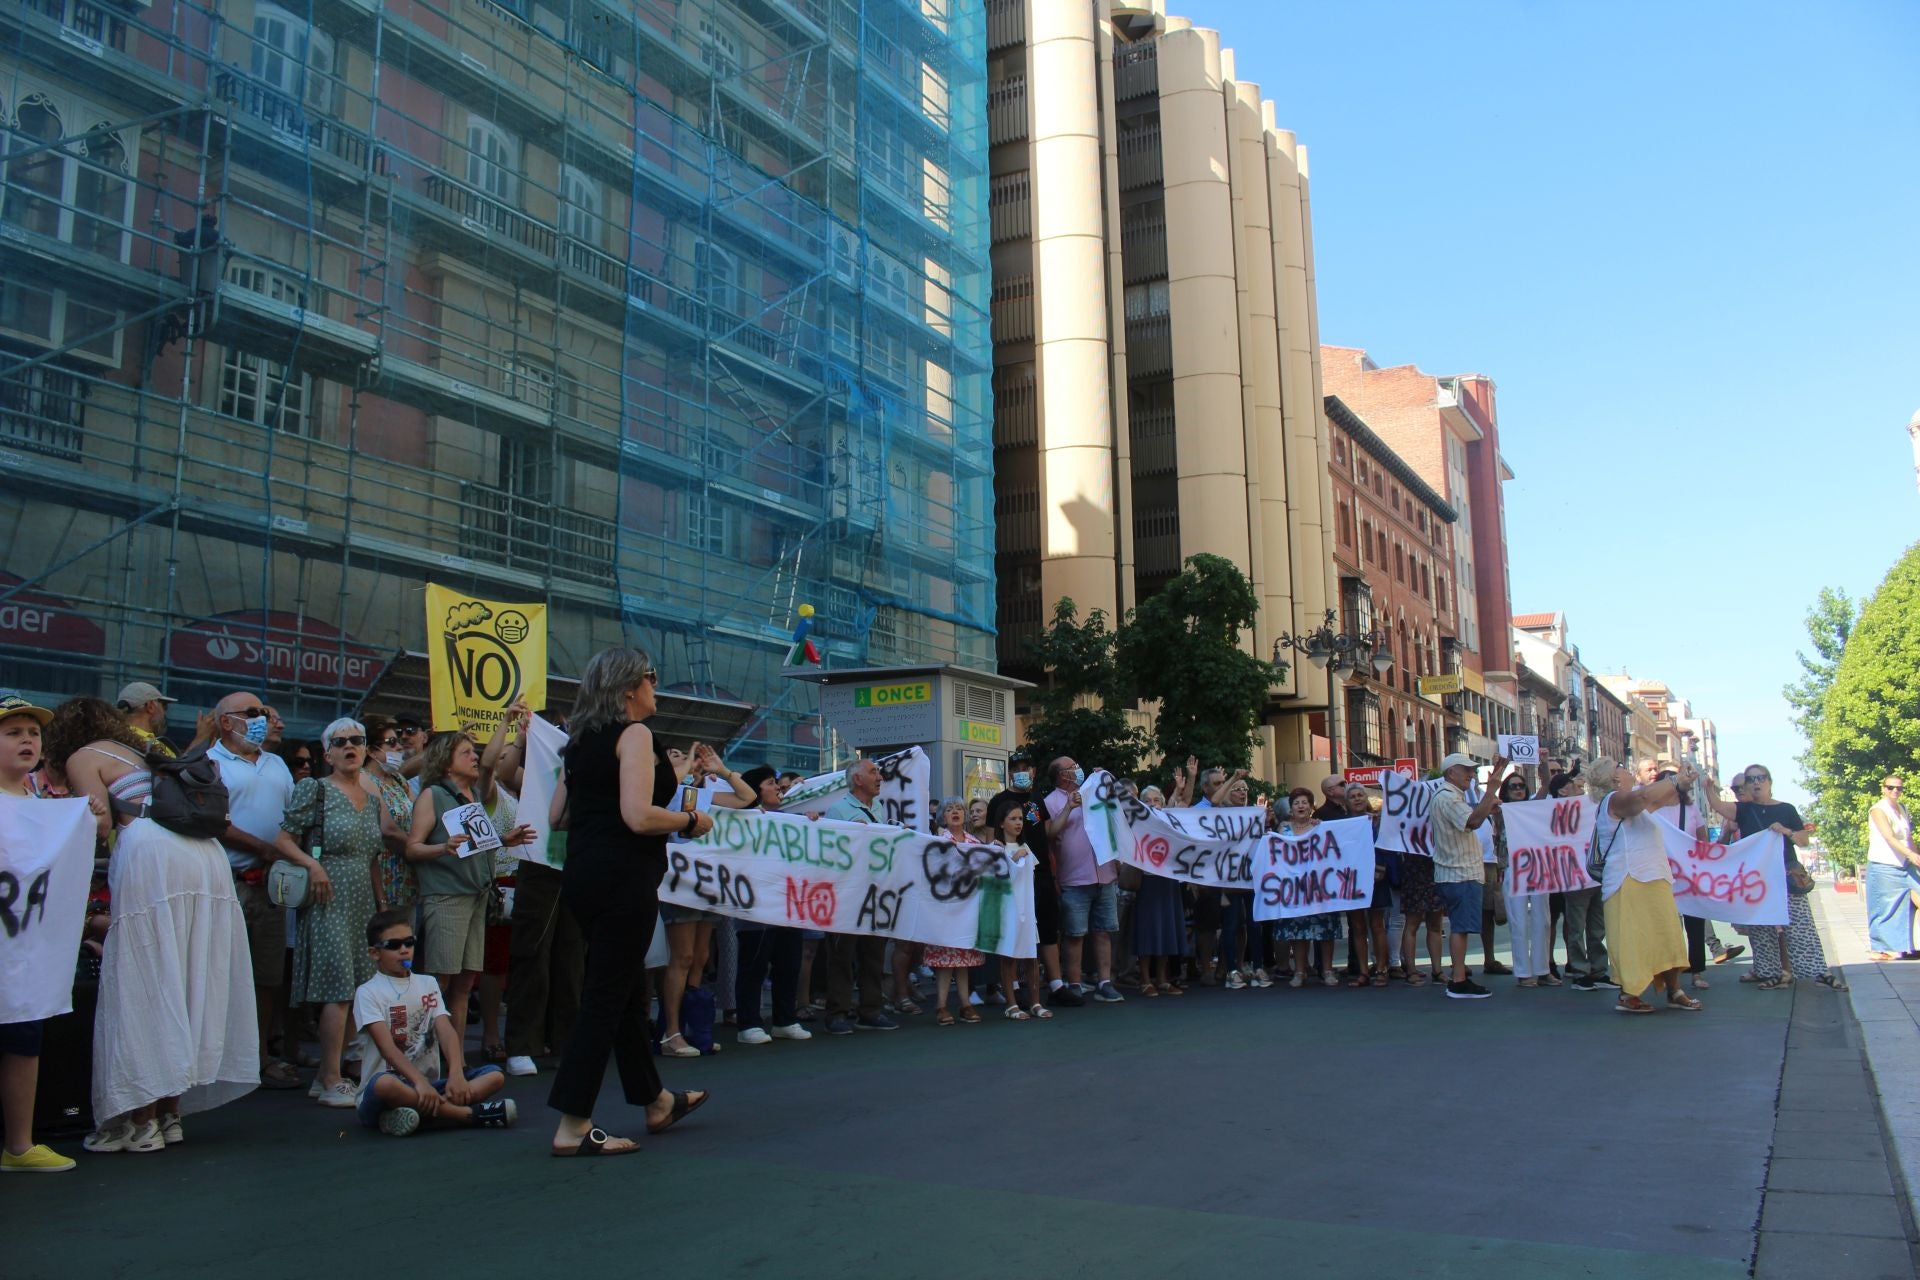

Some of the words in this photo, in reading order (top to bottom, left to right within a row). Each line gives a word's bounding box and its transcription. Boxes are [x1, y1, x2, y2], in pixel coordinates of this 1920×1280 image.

[448, 645, 512, 702] NO
[877, 685, 925, 702] ONCE
[971, 726, 998, 743] ONCE
[1511, 745, 1531, 757] NO
[469, 819, 491, 839] NO
[1550, 800, 1582, 836] NO
[1173, 845, 1212, 879] SE
[1268, 830, 1341, 866] FUERA
[1687, 840, 1727, 861] NO
[670, 851, 756, 910] PERO
[1260, 866, 1366, 907] SOMACYL
[1512, 843, 1587, 896] PLANTA
